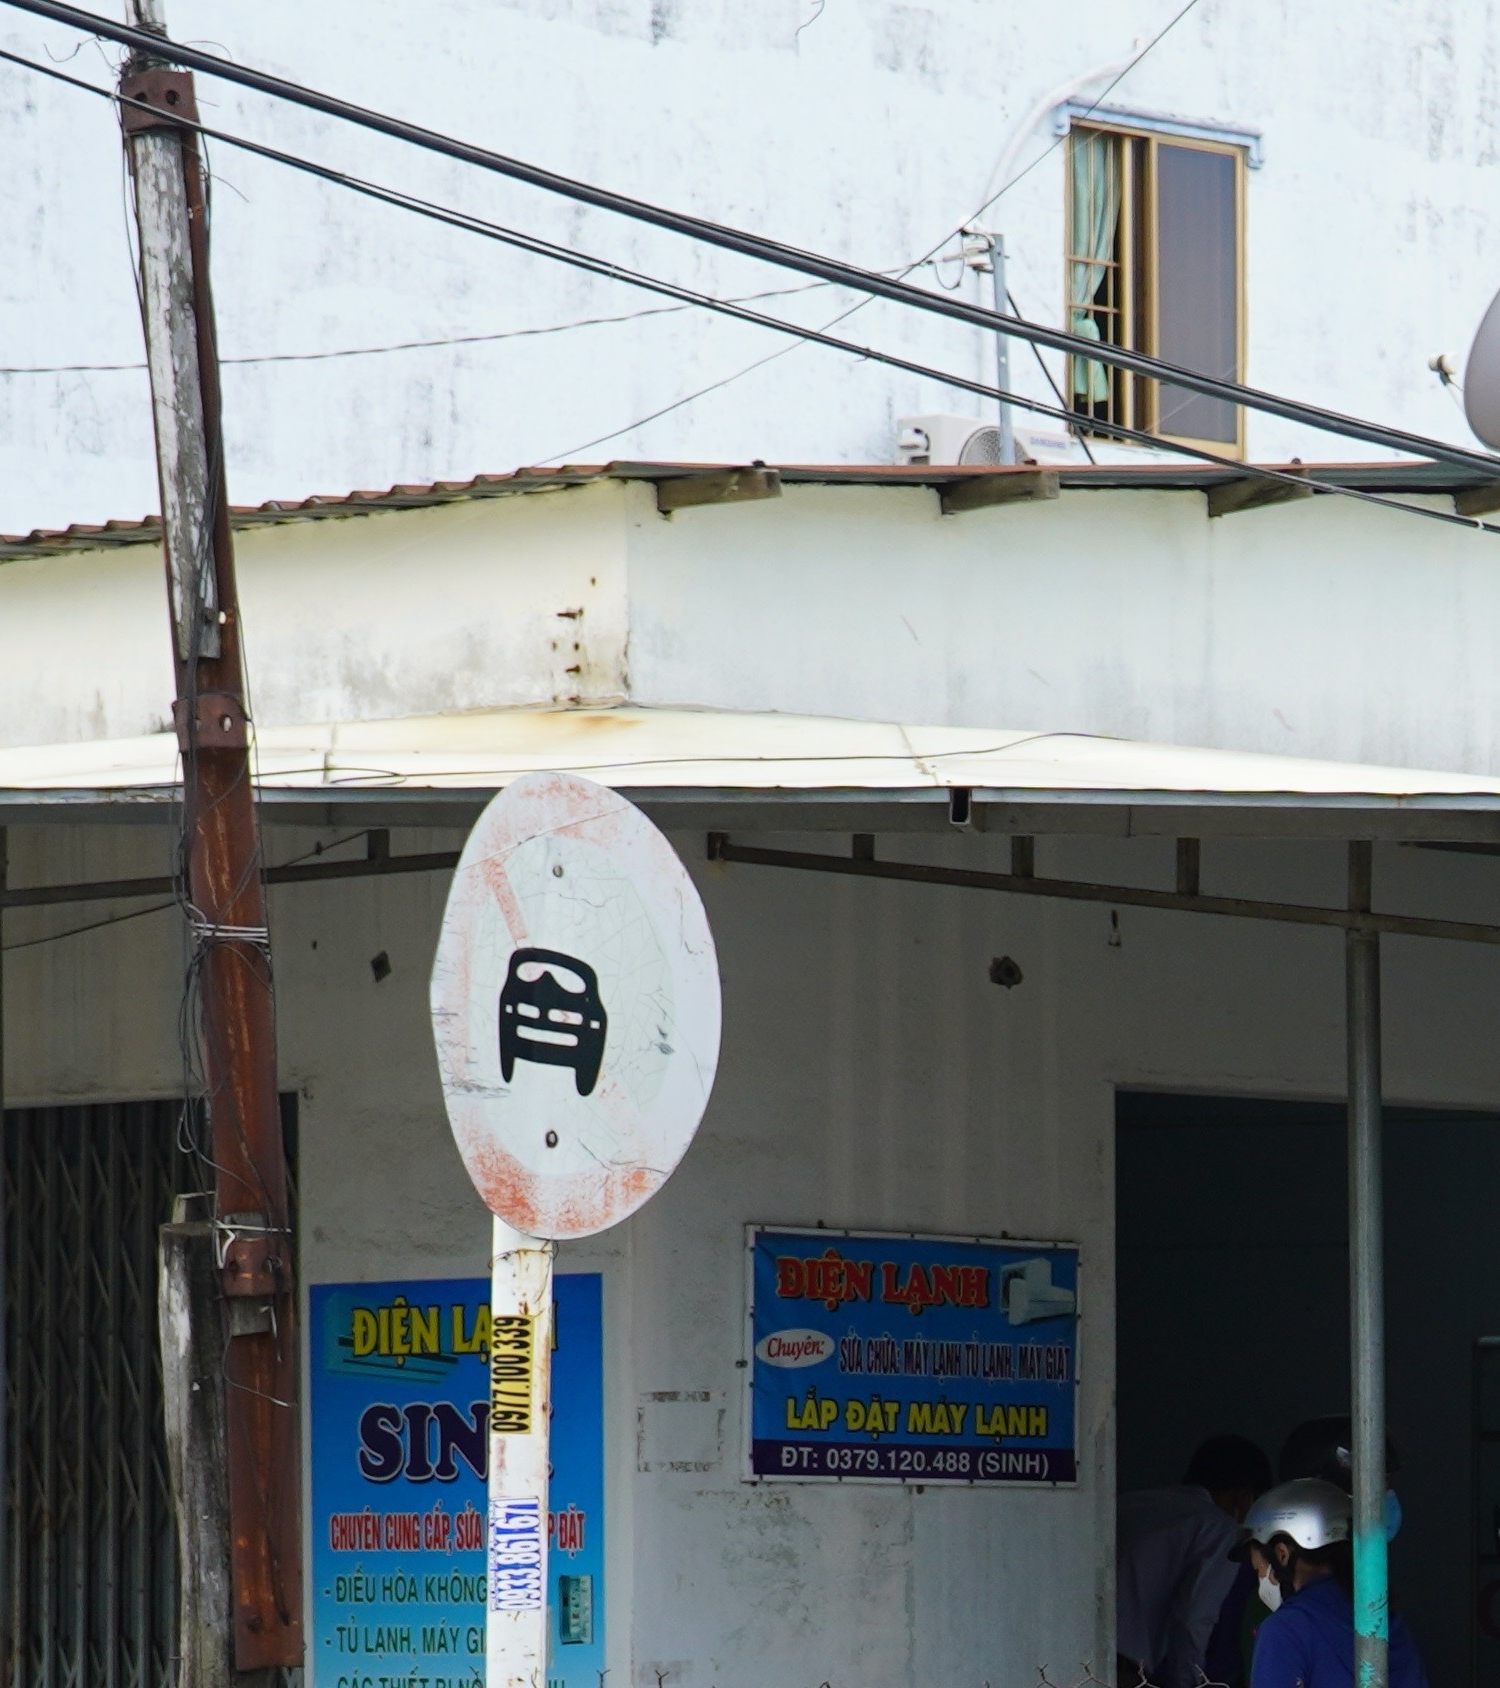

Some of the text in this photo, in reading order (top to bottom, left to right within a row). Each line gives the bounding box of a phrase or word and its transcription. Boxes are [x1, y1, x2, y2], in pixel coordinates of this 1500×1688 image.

[776, 1247, 989, 1315] ĐIỆN LẠNH
[352, 1296, 441, 1367] ĐIỆN
[903, 1332, 929, 1377] MÁY
[491, 1316, 531, 1433] 0977.100.339
[785, 1386, 839, 1431] LẮP
[907, 1397, 967, 1436] MÁY
[975, 1404, 1049, 1443] LẠNH
[781, 1447, 1050, 1477] ĐT: 0379.120.488 (SINH)
[330, 1505, 381, 1551] CHUYÊN
[385, 1513, 420, 1550] CUNG
[456, 1500, 483, 1550] SỬA
[557, 1504, 585, 1558] ĐẶT
[495, 1498, 542, 1611] 0933.861.671
[382, 1568, 419, 1603] HÒA
[422, 1617, 461, 1653] MÁY
